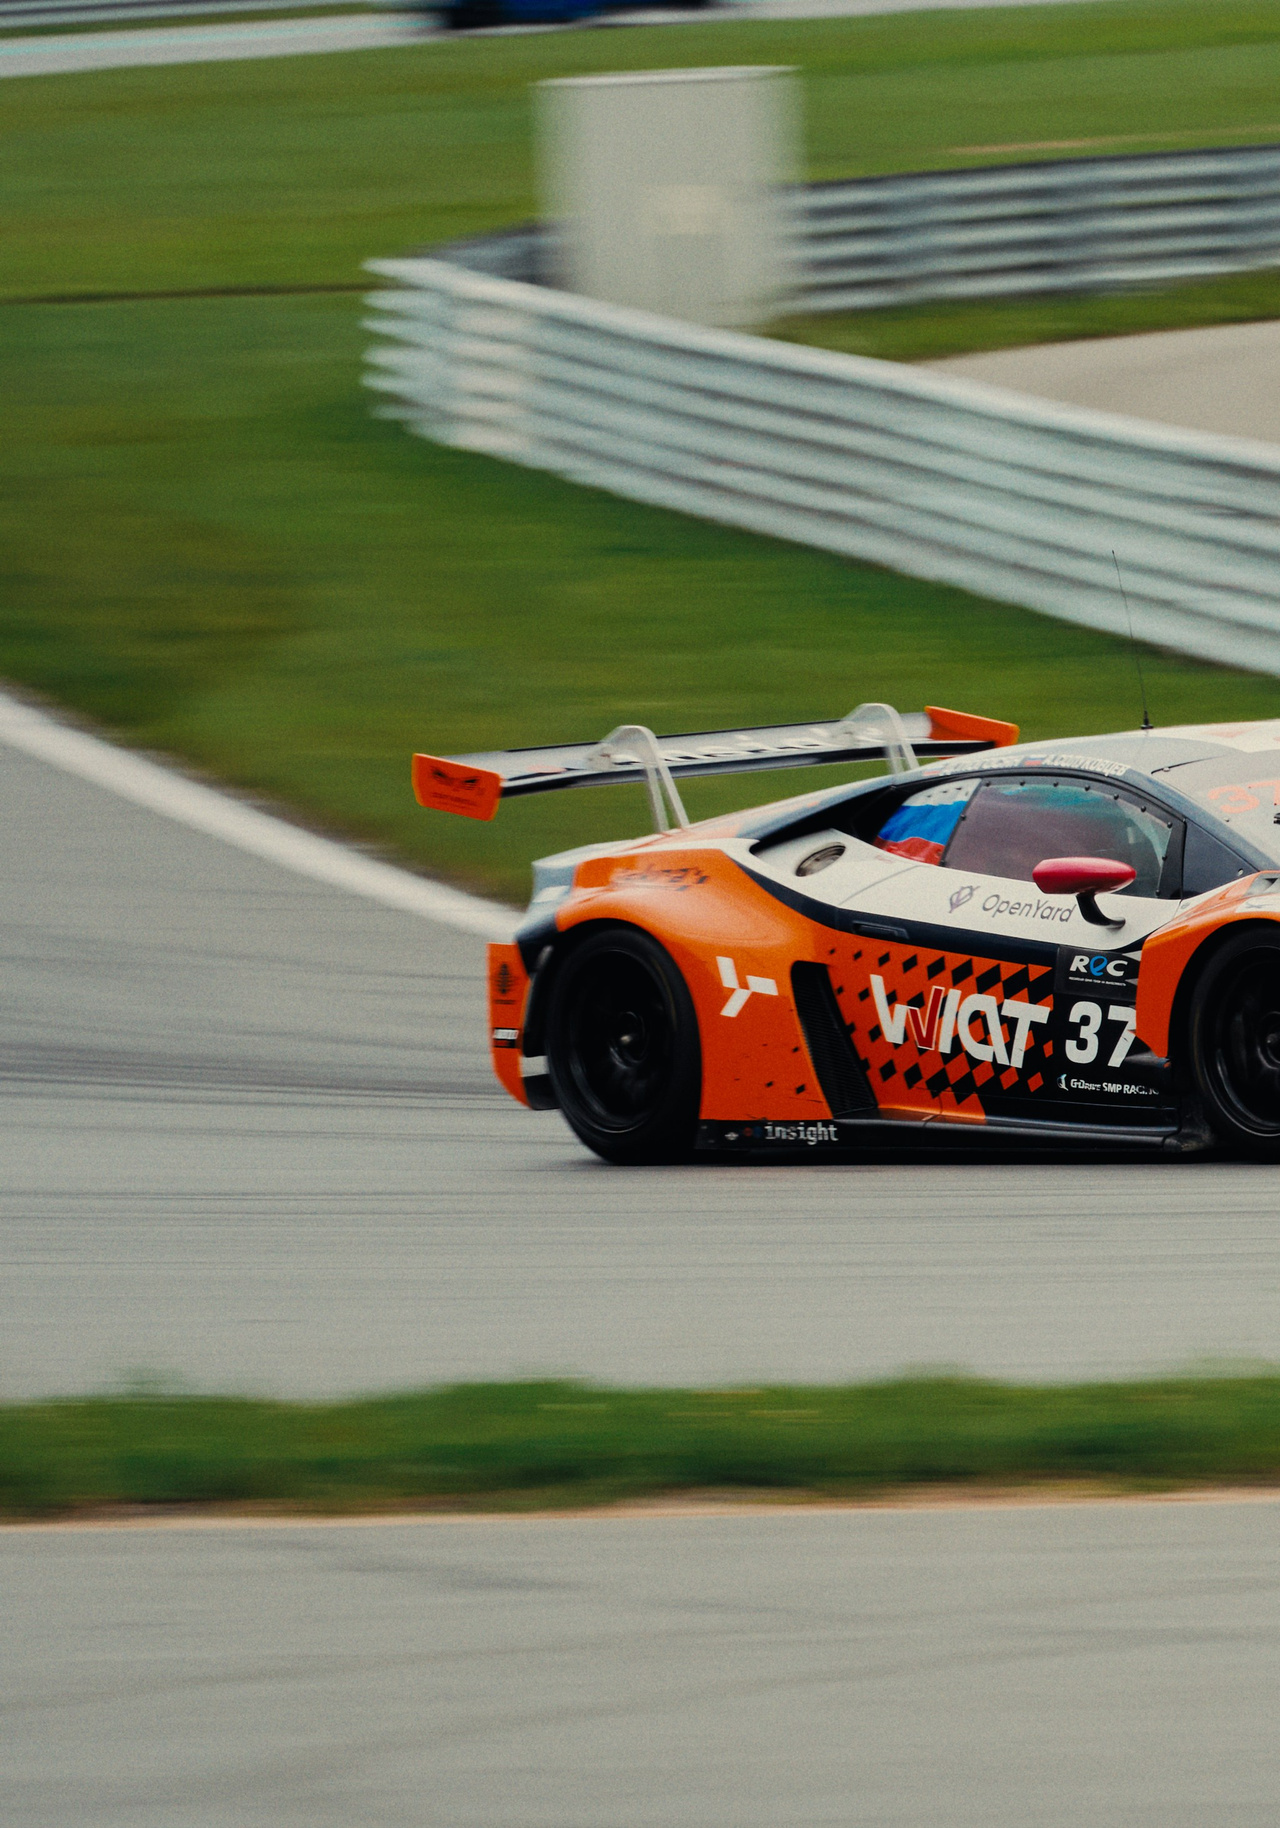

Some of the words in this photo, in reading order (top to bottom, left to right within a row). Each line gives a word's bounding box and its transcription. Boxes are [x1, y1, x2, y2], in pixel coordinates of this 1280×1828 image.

[982, 894, 1077, 922] OpenYard
[1065, 1000, 1137, 1068] 37
[1102, 1082, 1123, 1093] SMP
[764, 1122, 839, 1146] insight
